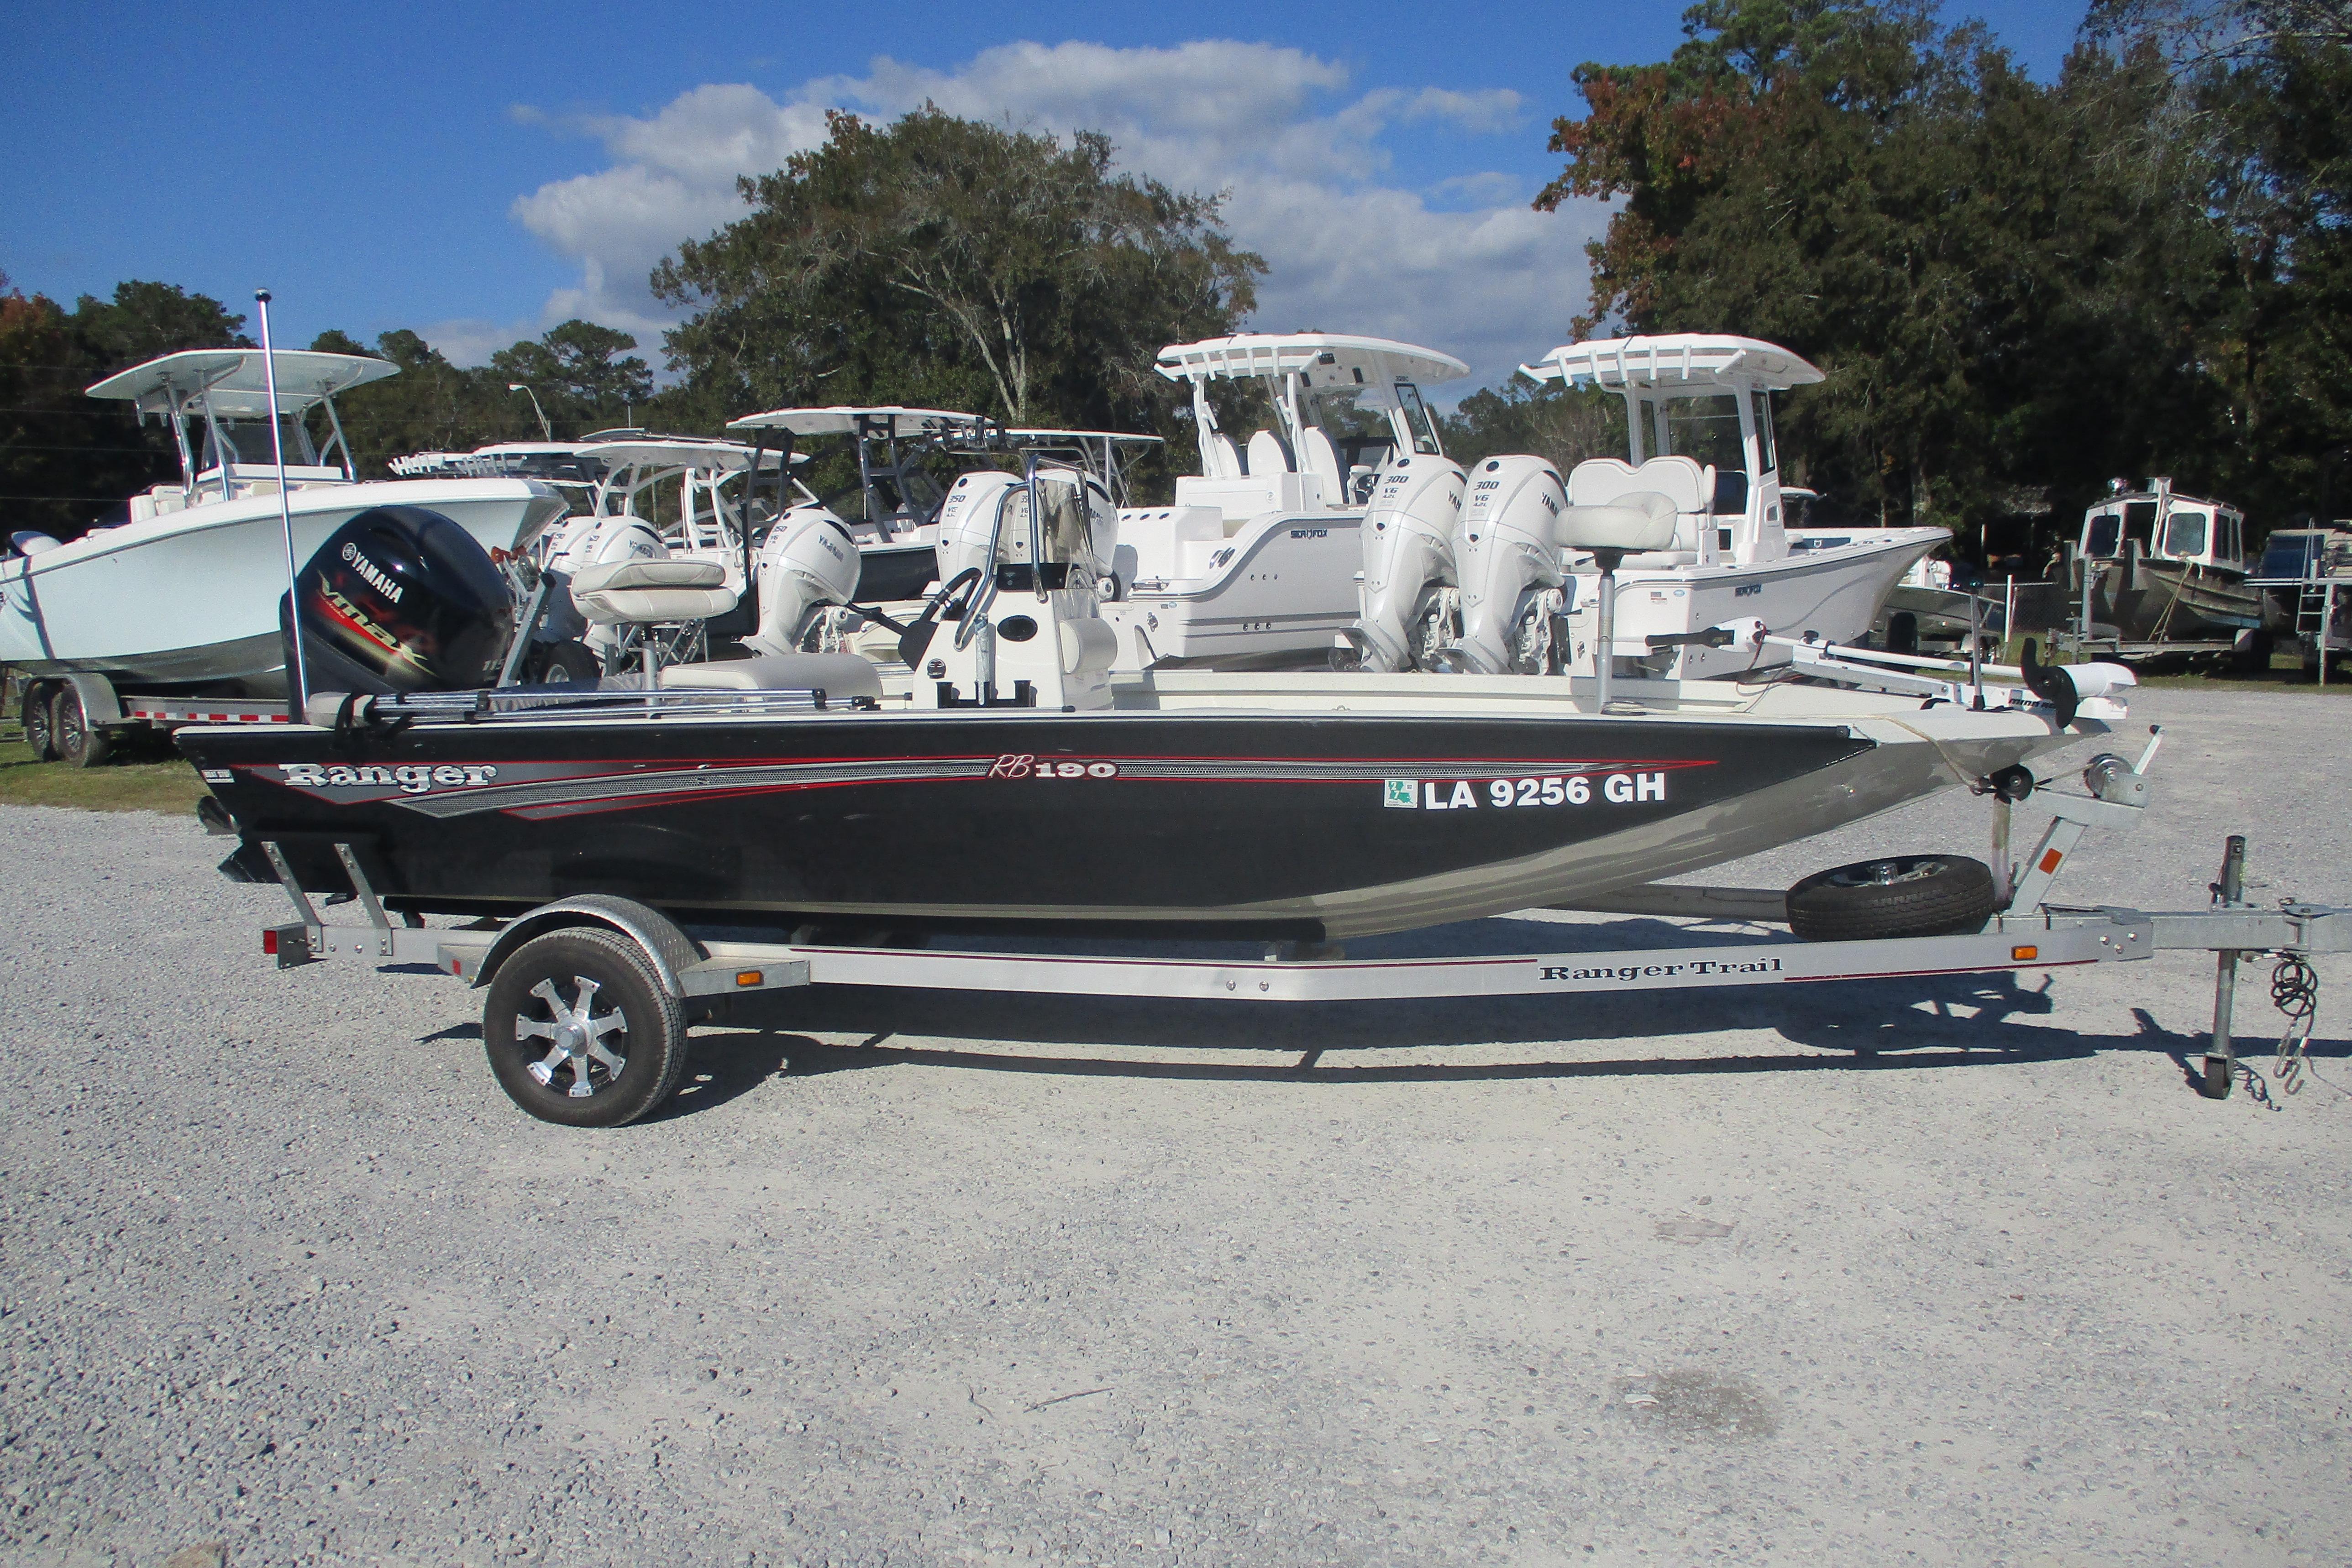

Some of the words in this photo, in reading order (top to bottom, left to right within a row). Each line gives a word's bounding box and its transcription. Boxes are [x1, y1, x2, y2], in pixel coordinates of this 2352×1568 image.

[1384, 476, 1409, 484] 300
[1474, 481, 1500, 491] 300
[1448, 490, 1461, 512] YAM
[350, 551, 404, 603] YAMAHA
[278, 763, 498, 793] Ranger
[1391, 781, 1397, 791] 2
[1394, 790, 1401, 799] 7
[1425, 781, 1478, 810] LA
[1490, 776, 1590, 807] 9256
[1604, 772, 1665, 803] GH
[1539, 964, 1684, 981] Ranger
[1690, 958, 1783, 975] Trail
